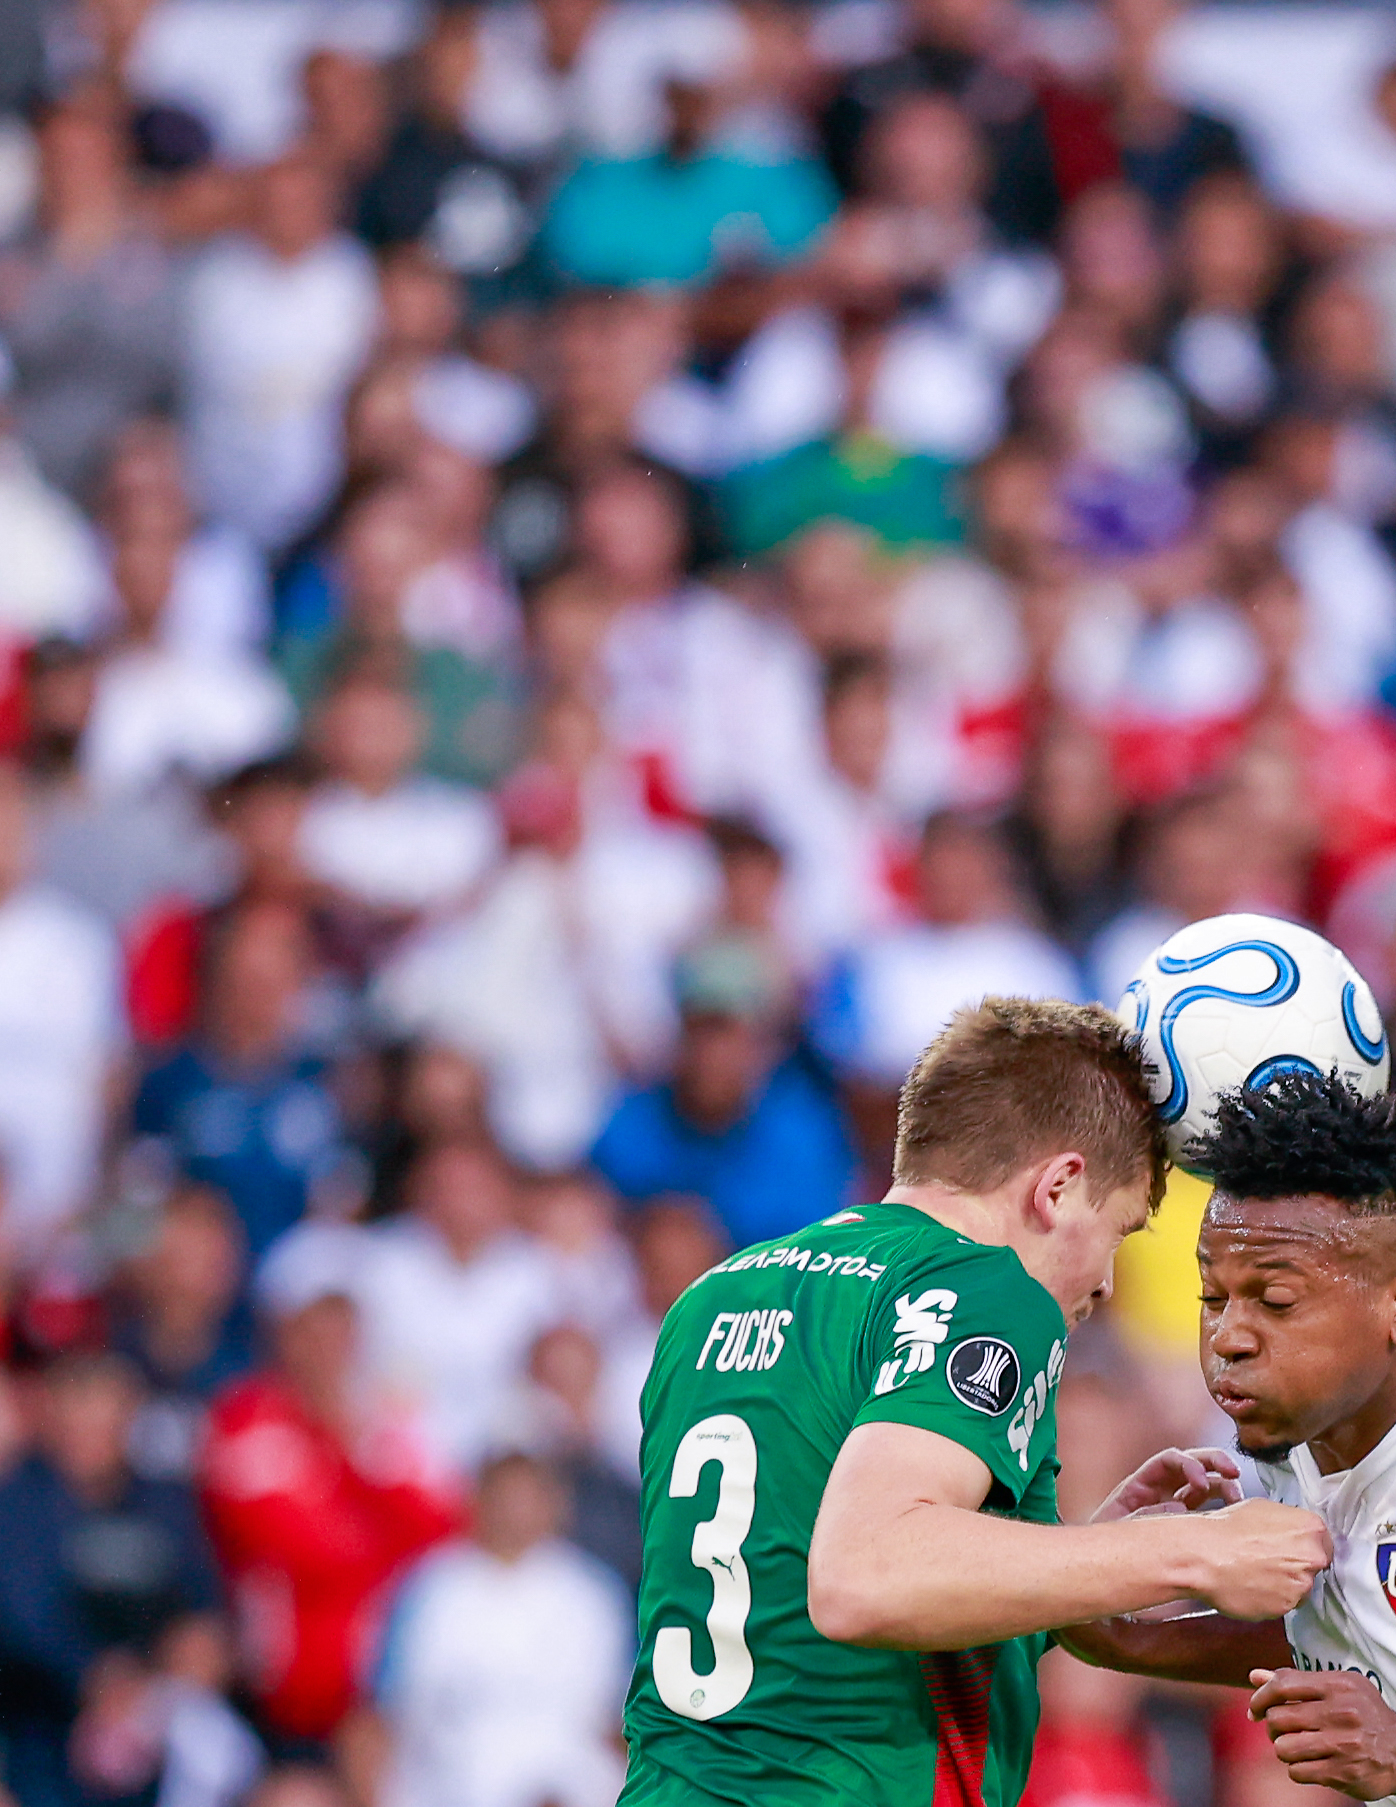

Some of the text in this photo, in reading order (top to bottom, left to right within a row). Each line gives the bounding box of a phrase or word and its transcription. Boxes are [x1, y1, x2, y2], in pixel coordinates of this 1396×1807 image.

[712, 1247, 887, 1281] LEAPMOTOR
[695, 1308, 794, 1373] FUCHS
[652, 1413, 758, 1722] 3
